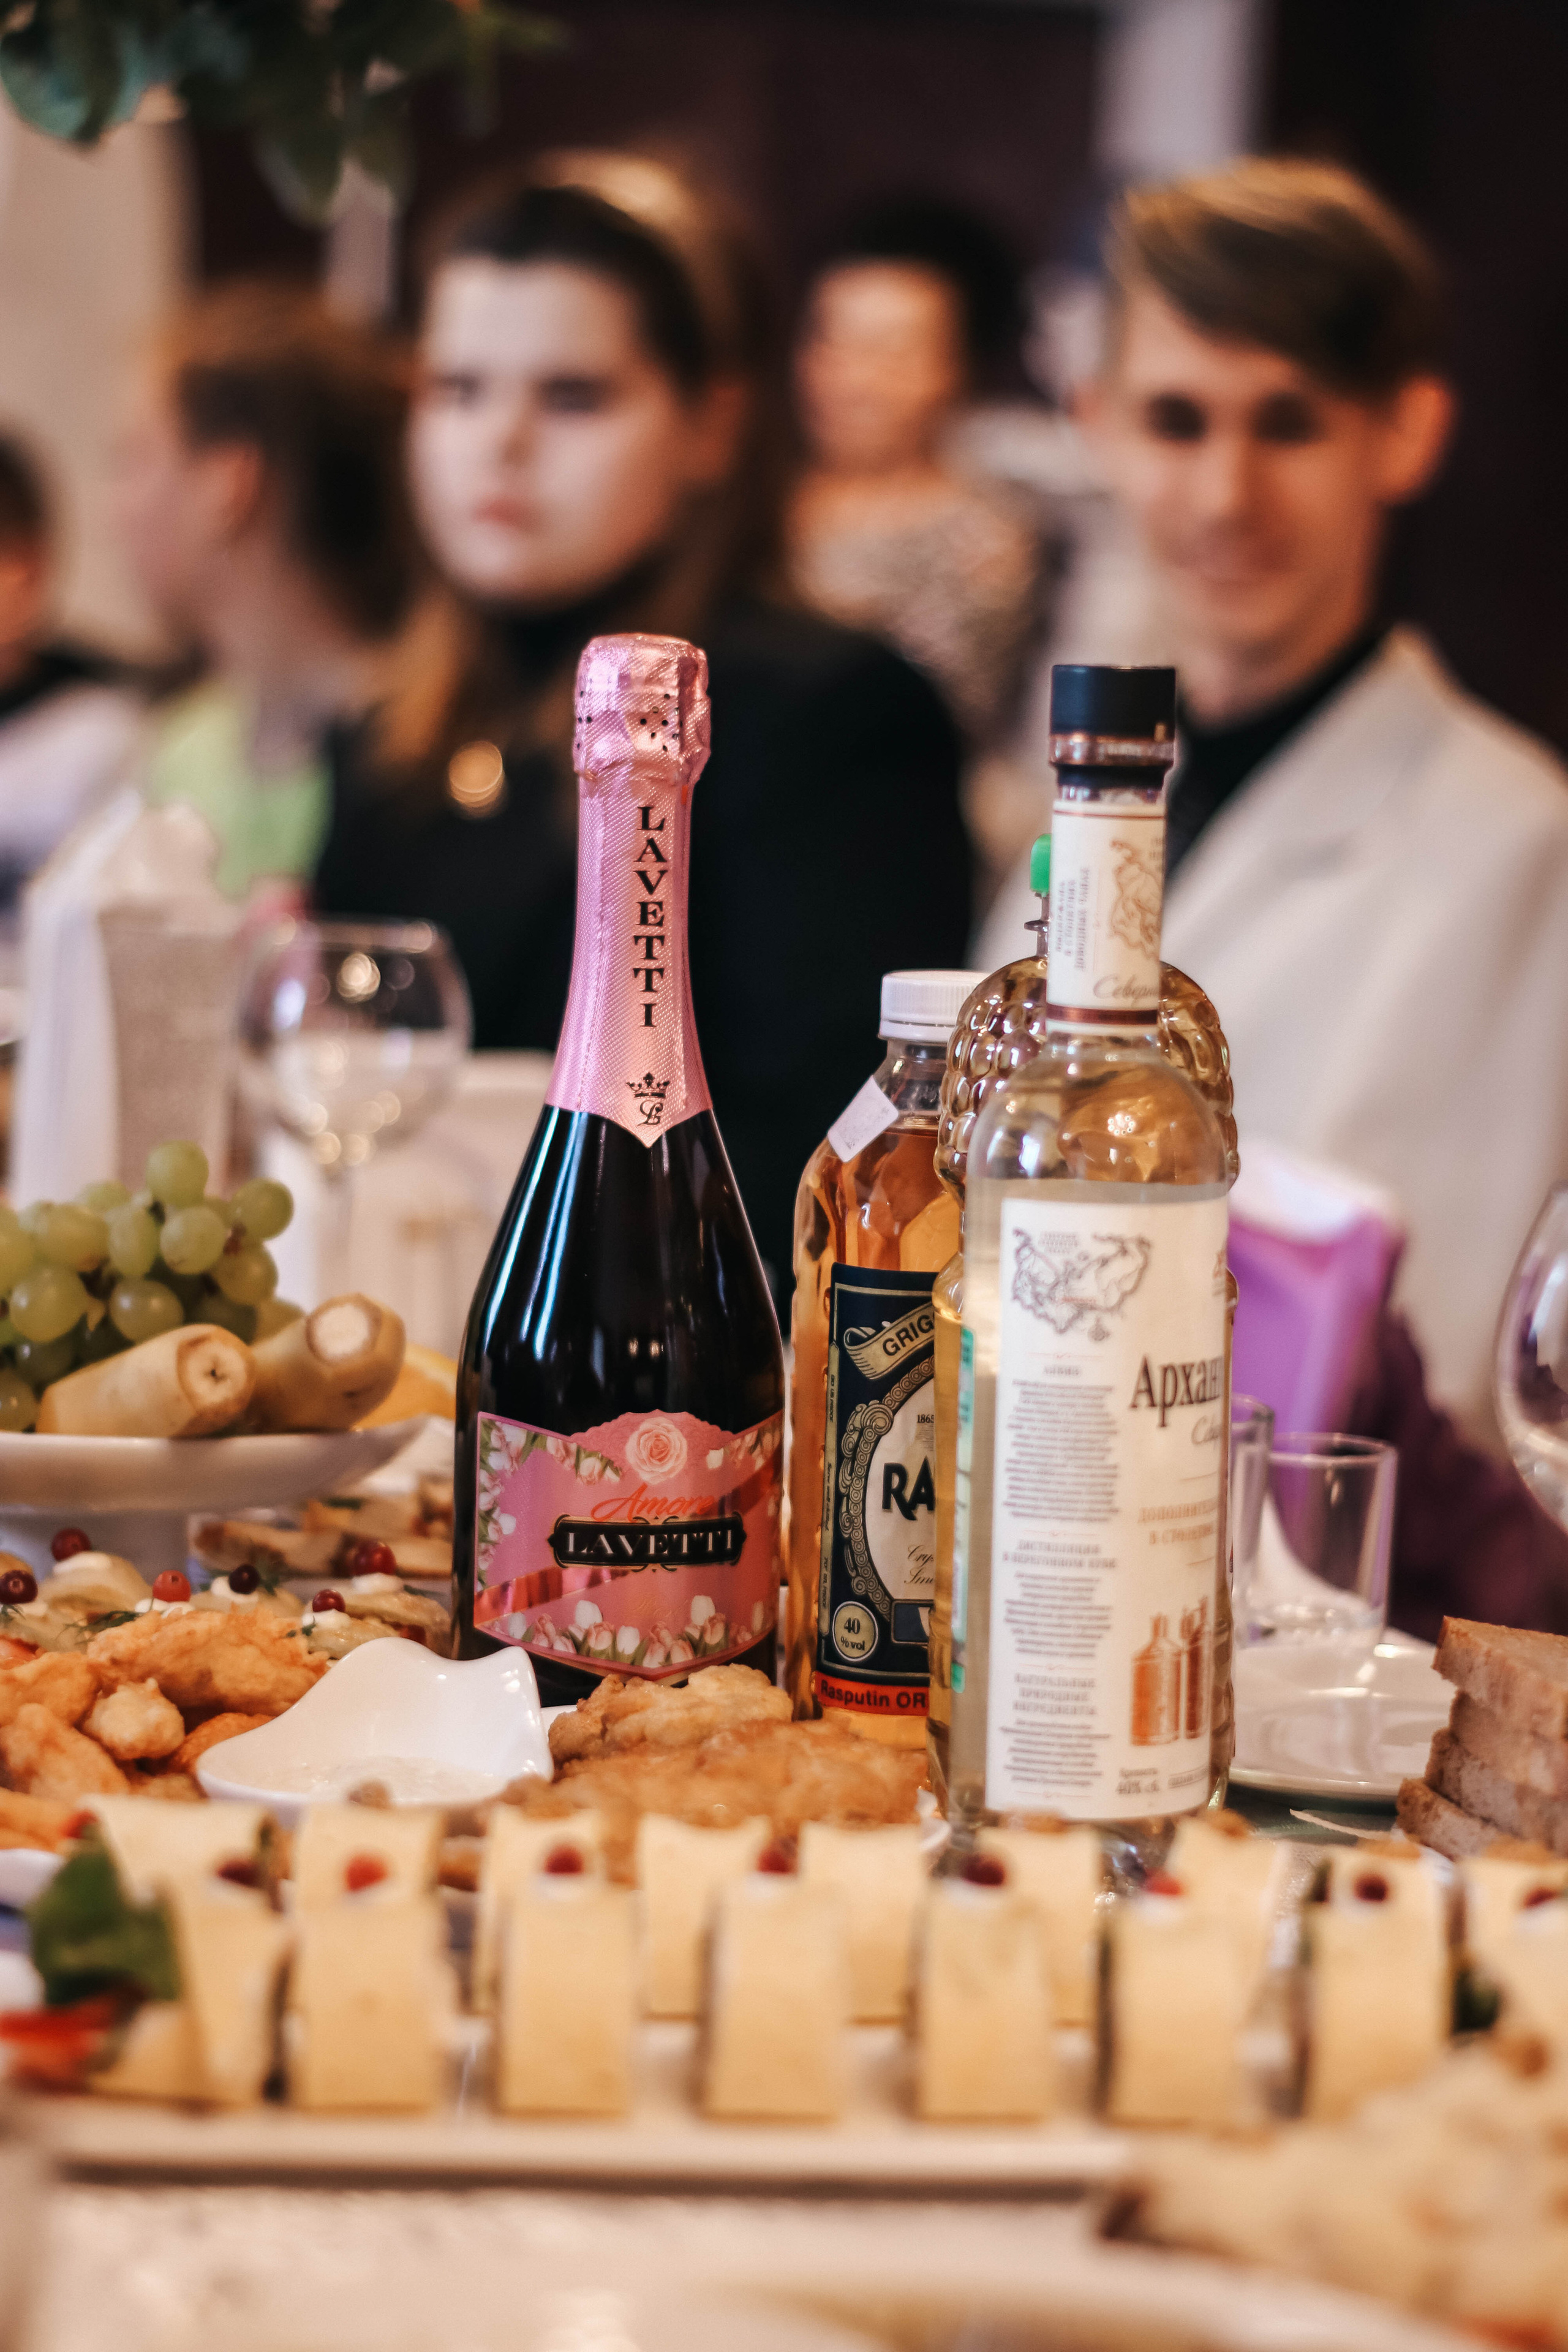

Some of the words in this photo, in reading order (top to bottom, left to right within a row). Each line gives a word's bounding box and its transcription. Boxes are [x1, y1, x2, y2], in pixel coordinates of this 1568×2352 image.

[633, 805, 668, 1028] LAVETTI
[883, 1313, 935, 1356] GRIG
[591, 1482, 715, 1523] Amore
[882, 1455, 935, 1521] RA
[567, 1529, 733, 1556] LAVETTI
[843, 1618, 861, 1635] 40
[850, 1640, 865, 1651] vol
[821, 1679, 890, 1707] Rasputin
[896, 1692, 926, 1708] OR
